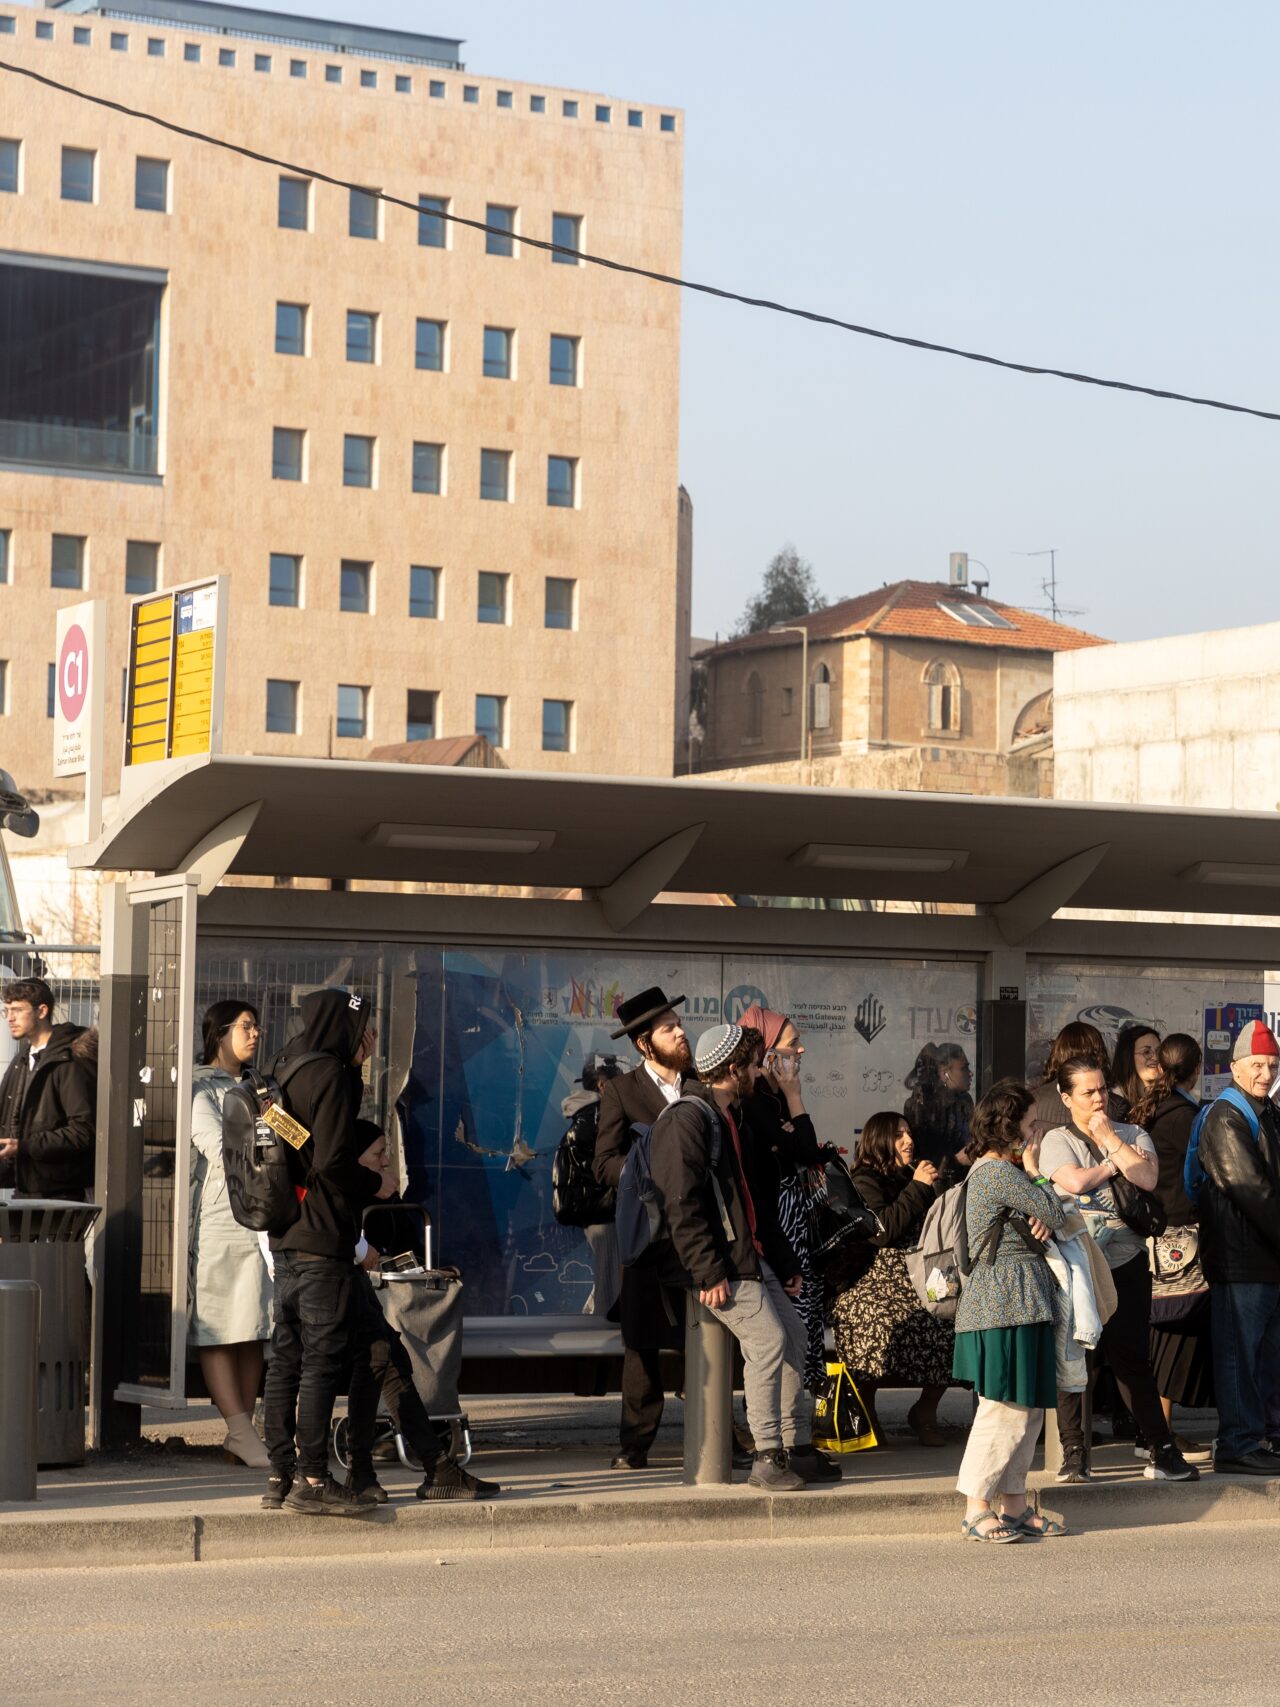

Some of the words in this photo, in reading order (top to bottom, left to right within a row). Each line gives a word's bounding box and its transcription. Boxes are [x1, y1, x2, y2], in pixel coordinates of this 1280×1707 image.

[63, 649, 83, 698] C1
[815, 1013, 846, 1022] Gateway
[908, 1006, 953, 1039] עדן
